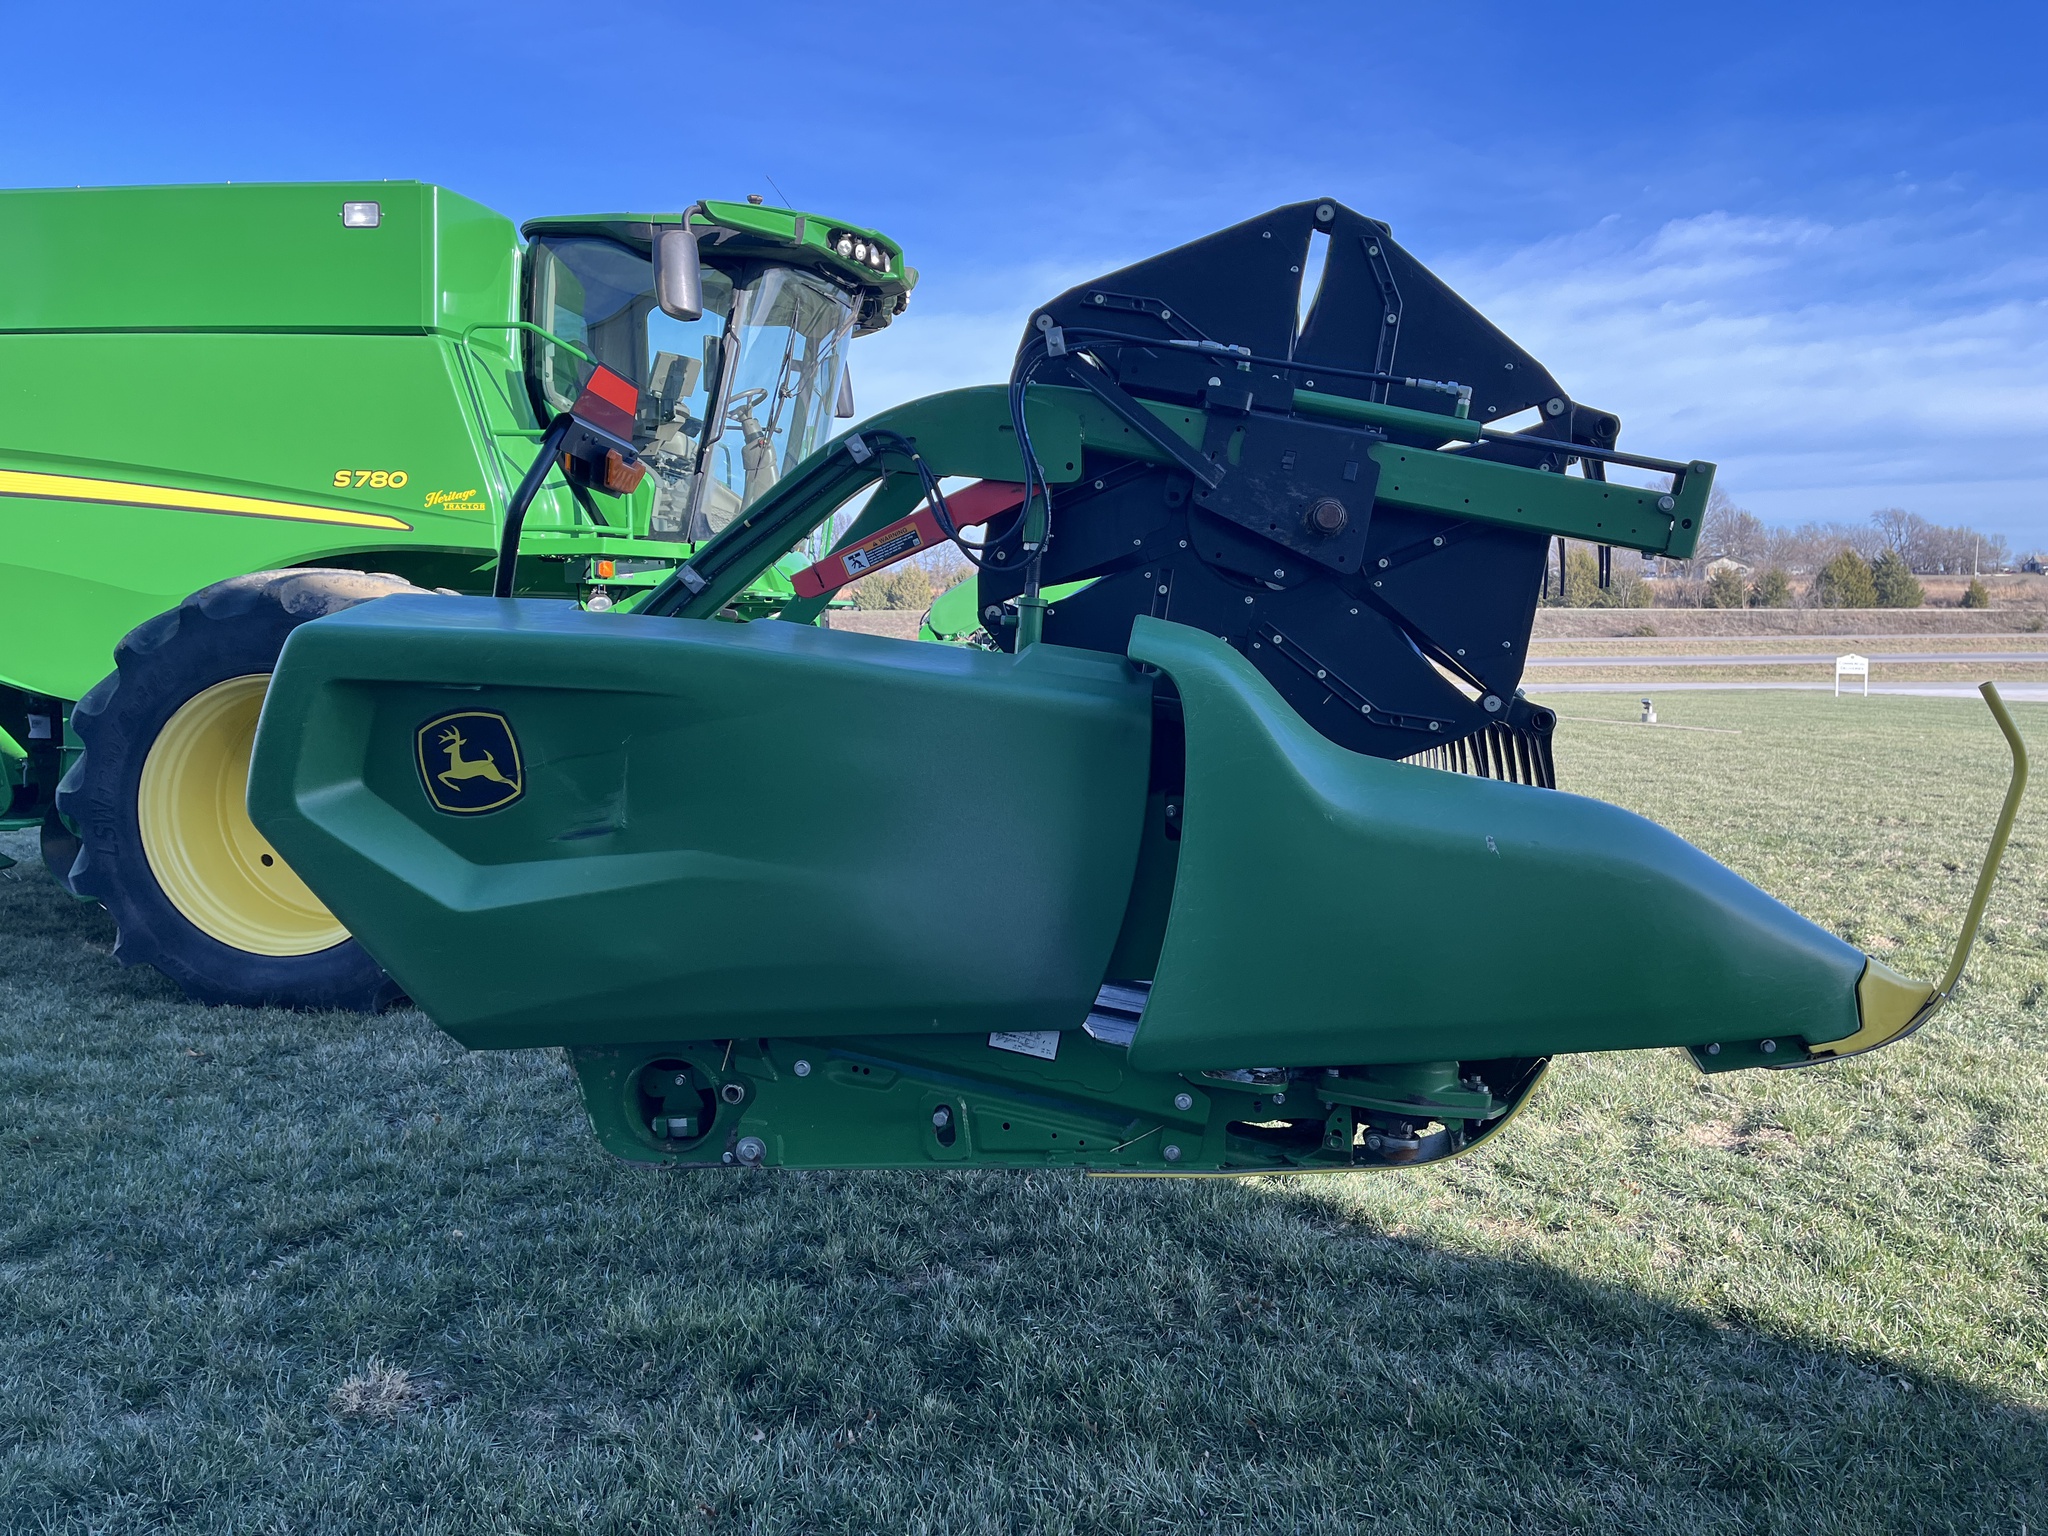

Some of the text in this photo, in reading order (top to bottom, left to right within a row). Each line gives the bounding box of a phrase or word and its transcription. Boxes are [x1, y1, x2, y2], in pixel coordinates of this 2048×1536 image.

[333, 469, 409, 489] S780
[424, 489, 477, 508] Heritage
[443, 502, 486, 511] TRACTOR
[878, 527, 908, 543] WARNING
